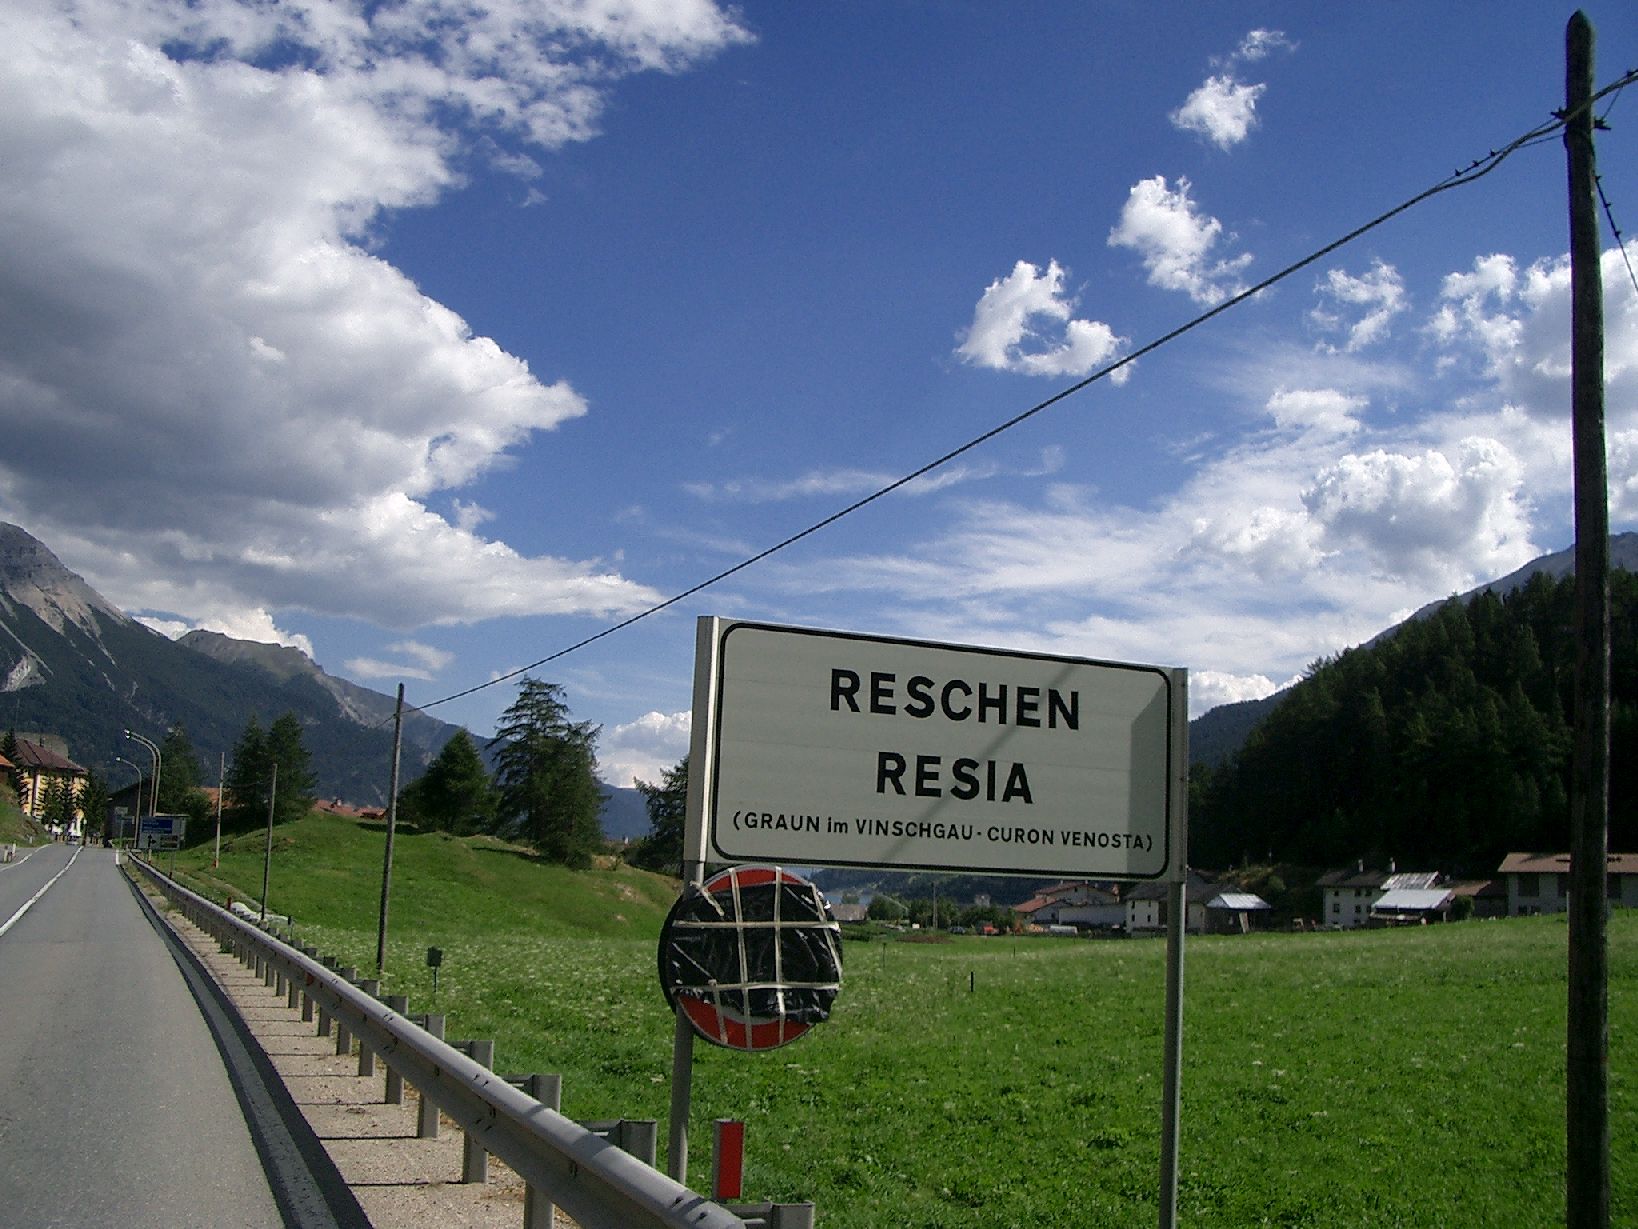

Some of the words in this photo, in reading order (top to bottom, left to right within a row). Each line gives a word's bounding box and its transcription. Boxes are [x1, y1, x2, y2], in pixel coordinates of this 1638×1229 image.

[831, 668, 1079, 730] RESCHEN
[877, 751, 1033, 804] RESIA
[733, 811, 819, 833] (GRAUN
[828, 816, 849, 834] im
[1061, 830, 1153, 852] VENOSTA)
